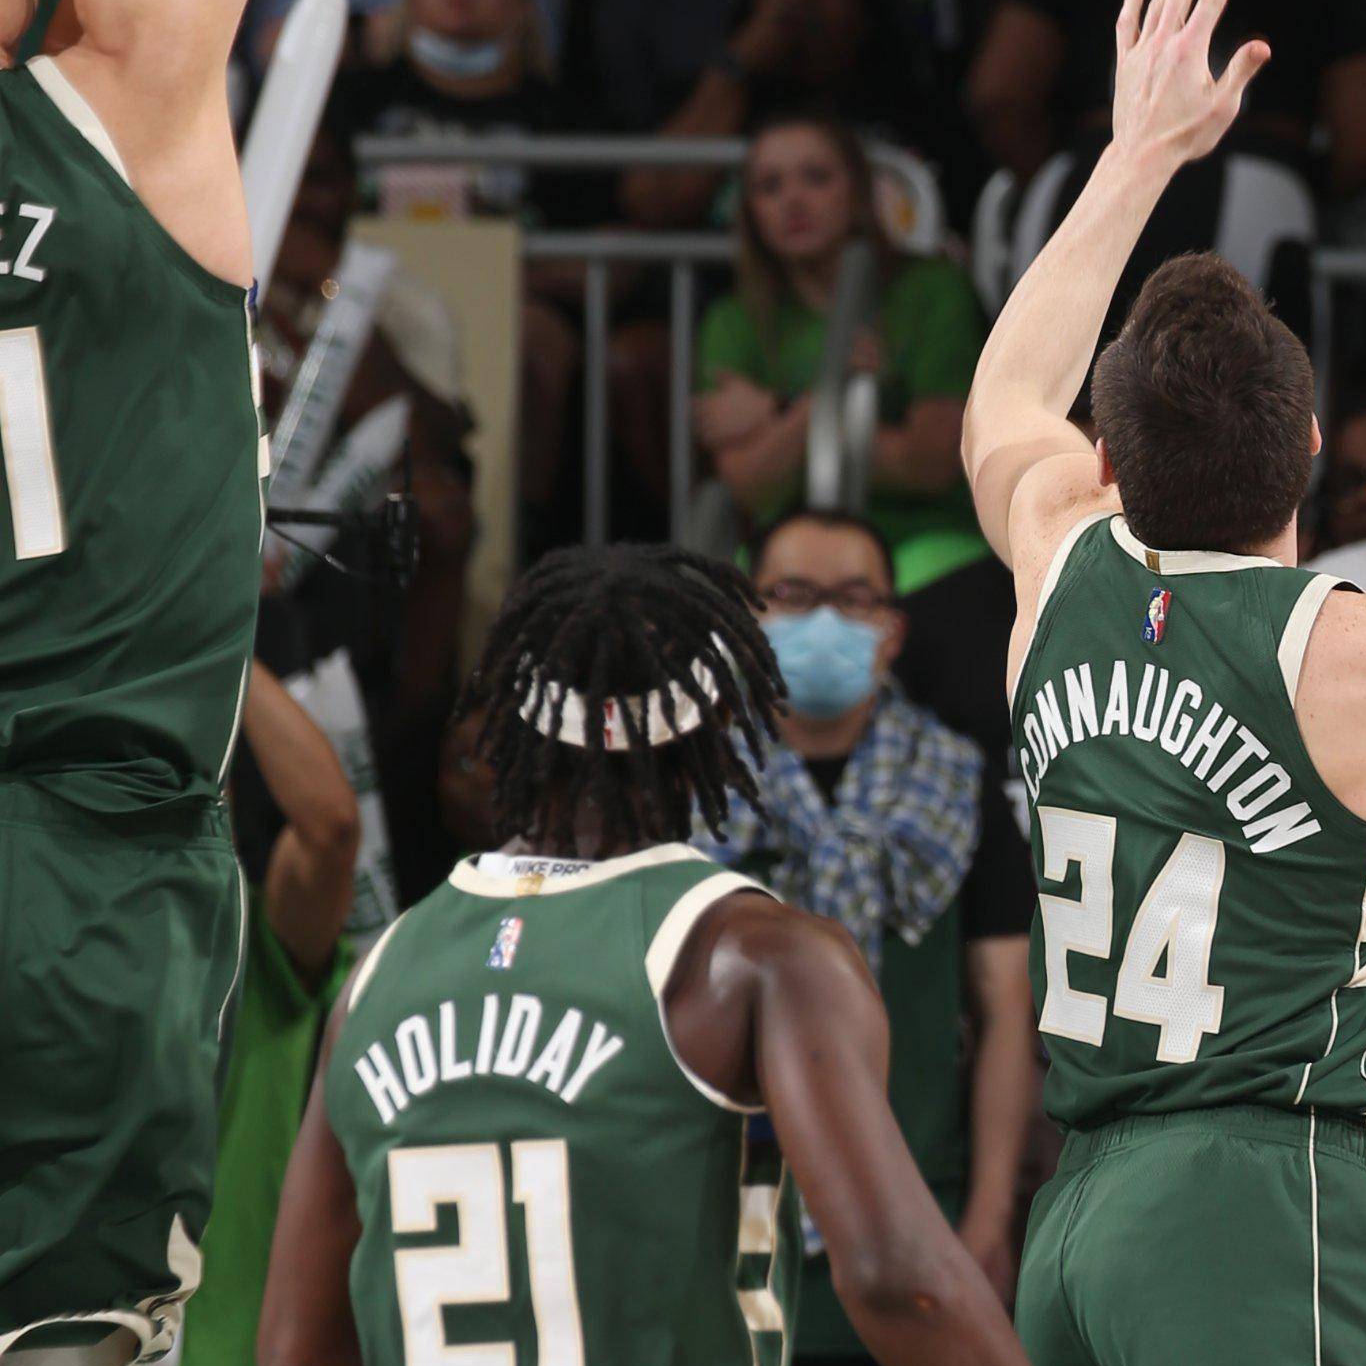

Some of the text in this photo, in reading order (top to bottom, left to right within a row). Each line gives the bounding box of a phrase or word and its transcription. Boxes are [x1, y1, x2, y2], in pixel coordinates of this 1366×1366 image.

[1020, 660, 1322, 854] CONNAUGHTON
[1037, 805, 1227, 1064] 24
[354, 992, 625, 1126] HOLIDAY
